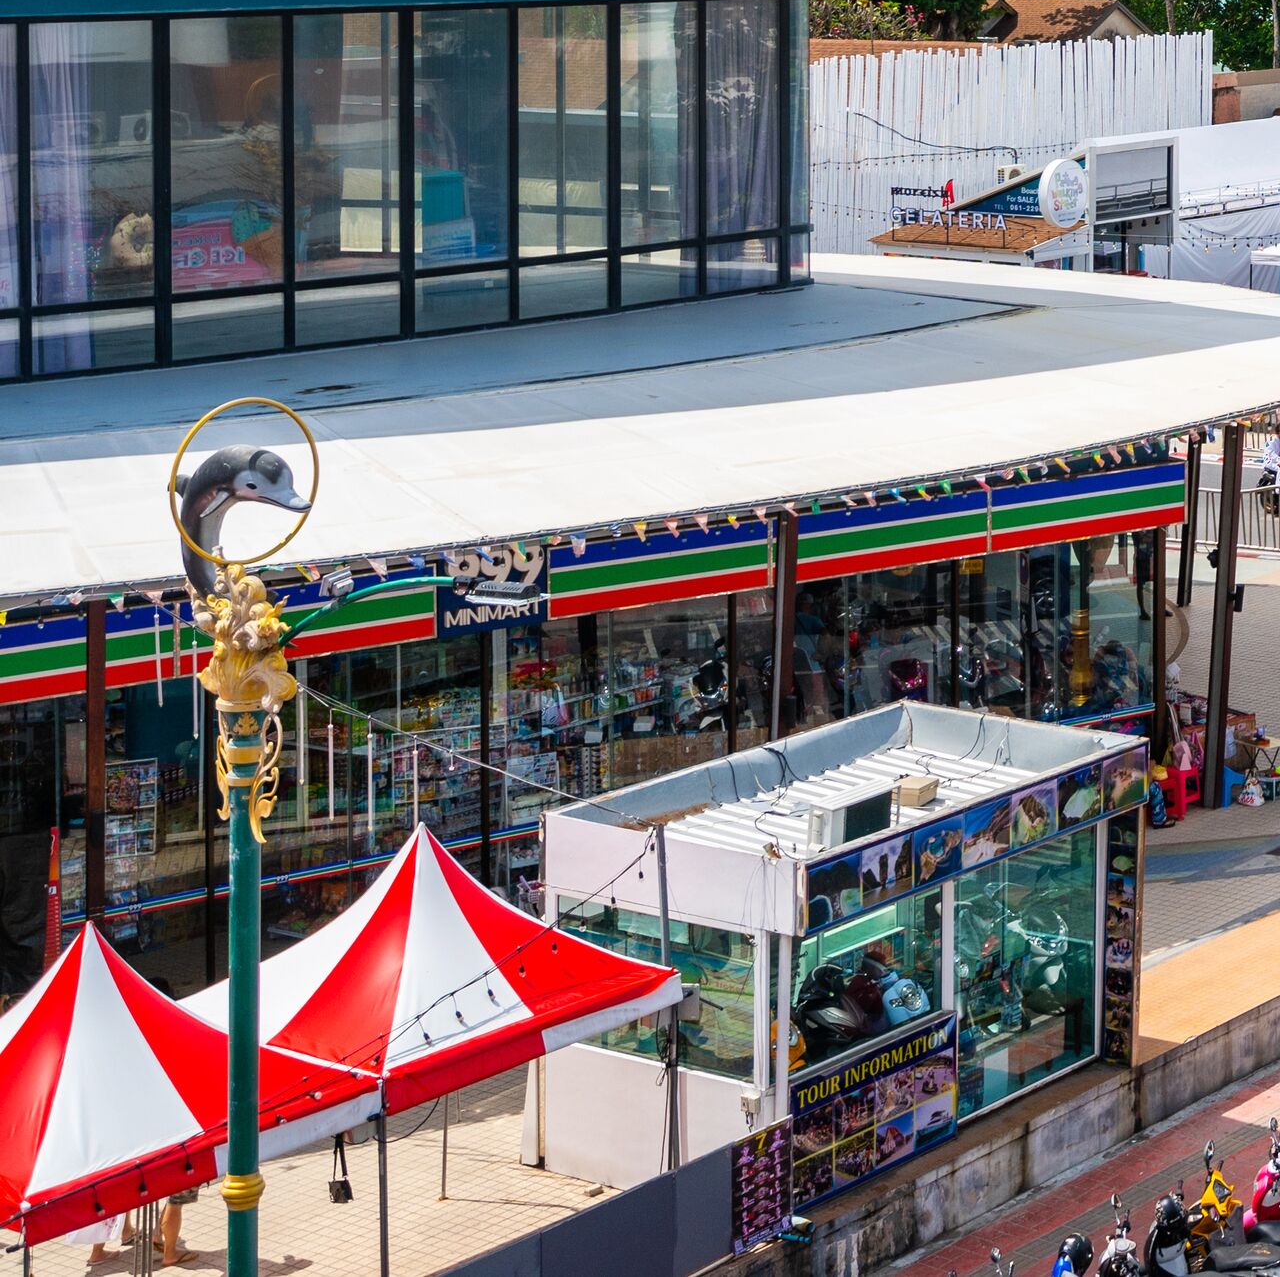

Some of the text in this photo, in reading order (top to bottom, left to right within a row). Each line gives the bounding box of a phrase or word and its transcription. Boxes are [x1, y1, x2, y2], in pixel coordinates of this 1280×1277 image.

[890, 206, 1007, 230] GELATERIA
[444, 600, 539, 628] MINIMART
[797, 1027, 948, 1108] TOUR INFORMATION
